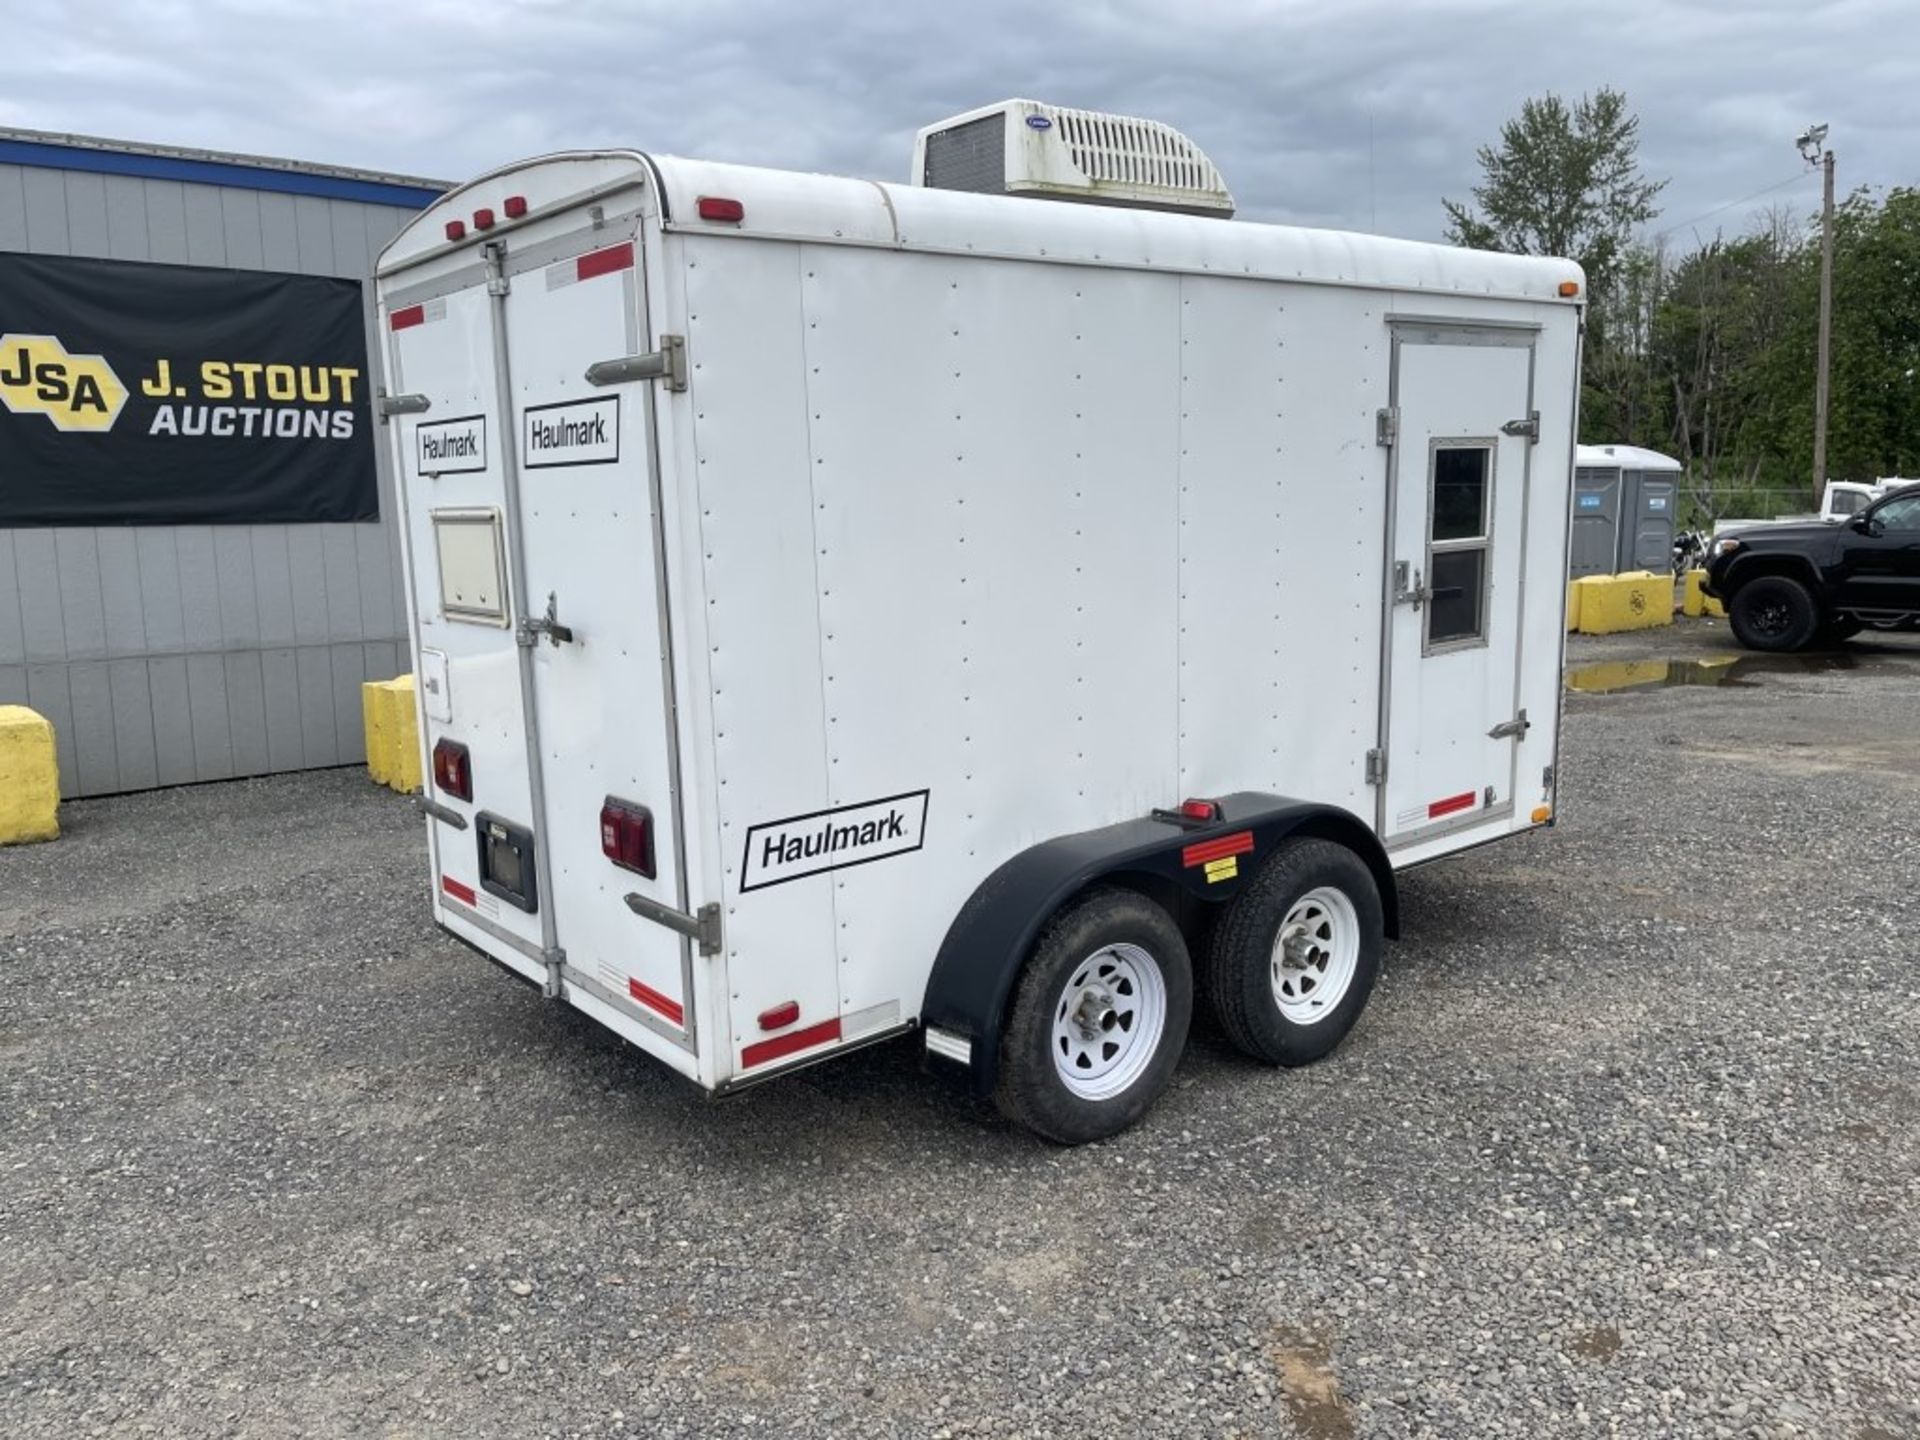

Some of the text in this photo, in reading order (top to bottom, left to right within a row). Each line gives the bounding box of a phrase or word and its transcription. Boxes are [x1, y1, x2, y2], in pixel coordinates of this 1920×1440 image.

[1, 348, 108, 413] JSA
[141, 359, 360, 403] J. STOUT
[148, 405, 355, 439] AUCTIONS
